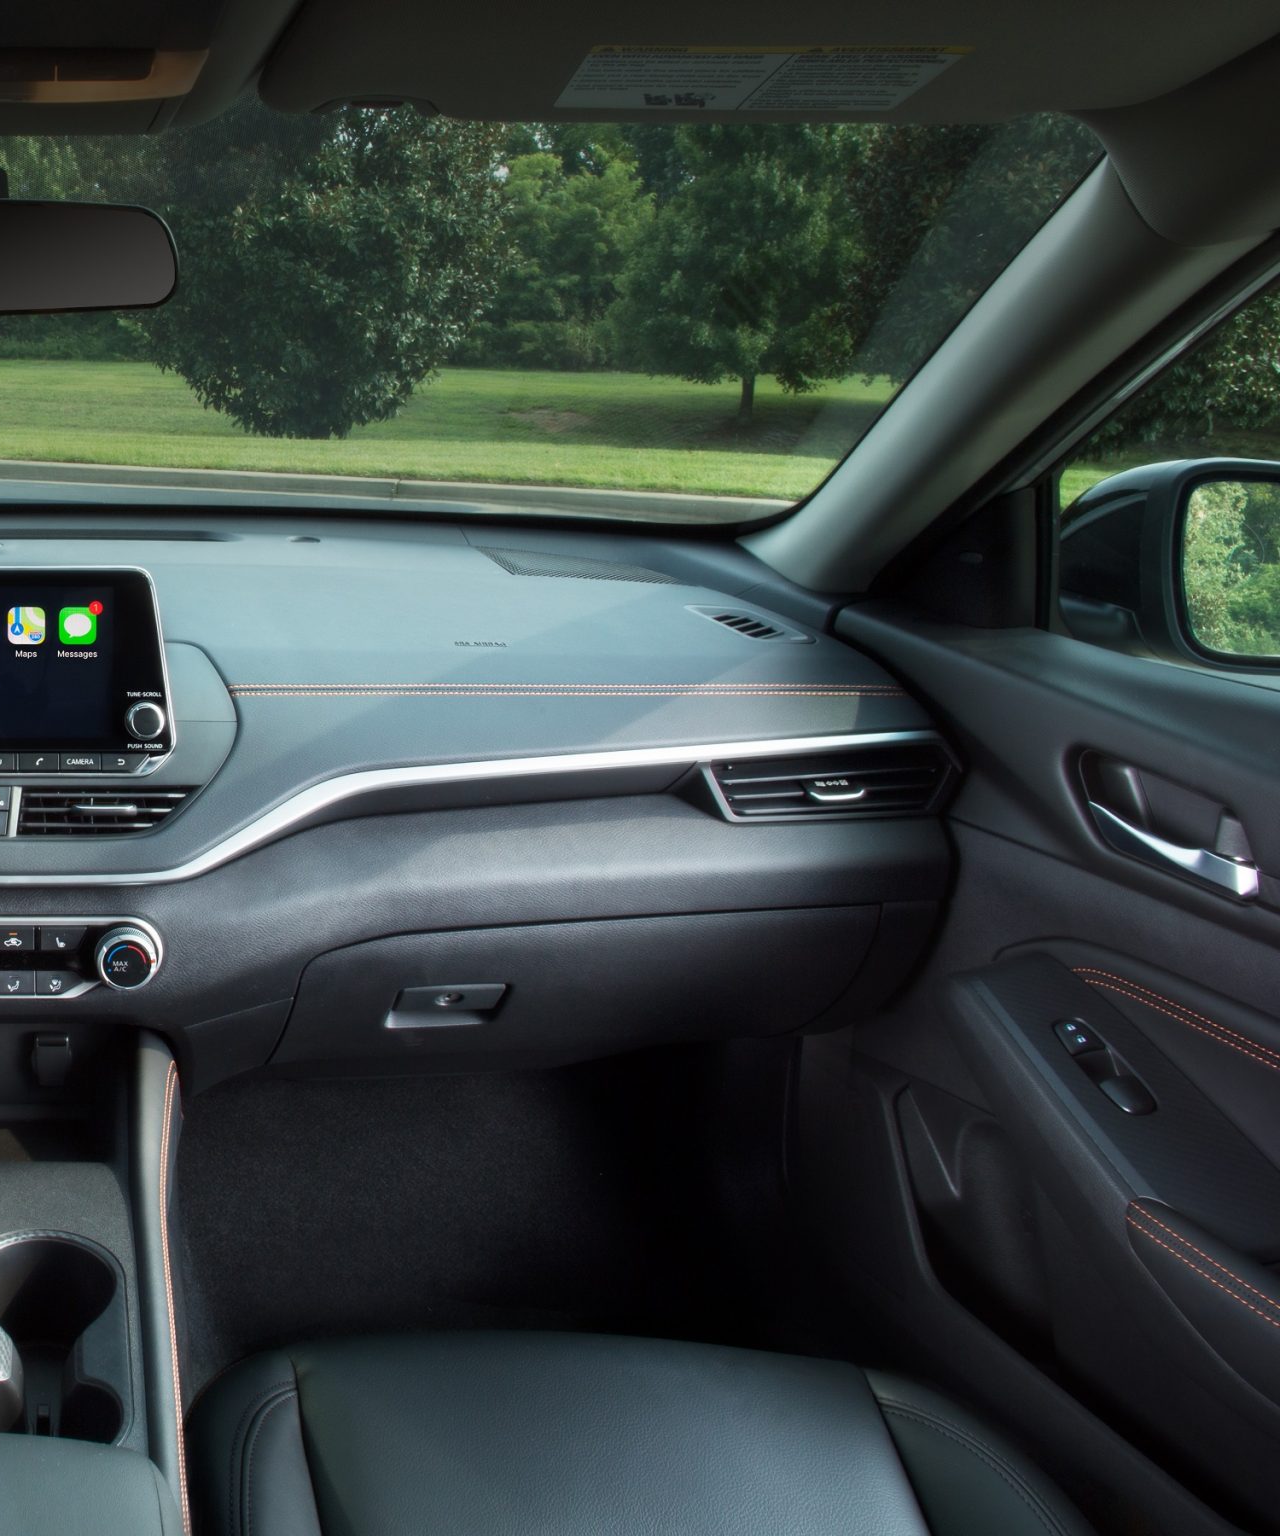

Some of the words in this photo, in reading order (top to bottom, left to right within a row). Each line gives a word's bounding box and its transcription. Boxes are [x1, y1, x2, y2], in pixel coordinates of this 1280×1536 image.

[15, 650, 38, 659] Maps
[57, 650, 98, 660] Messages
[66, 758, 94, 766] CAMERA
